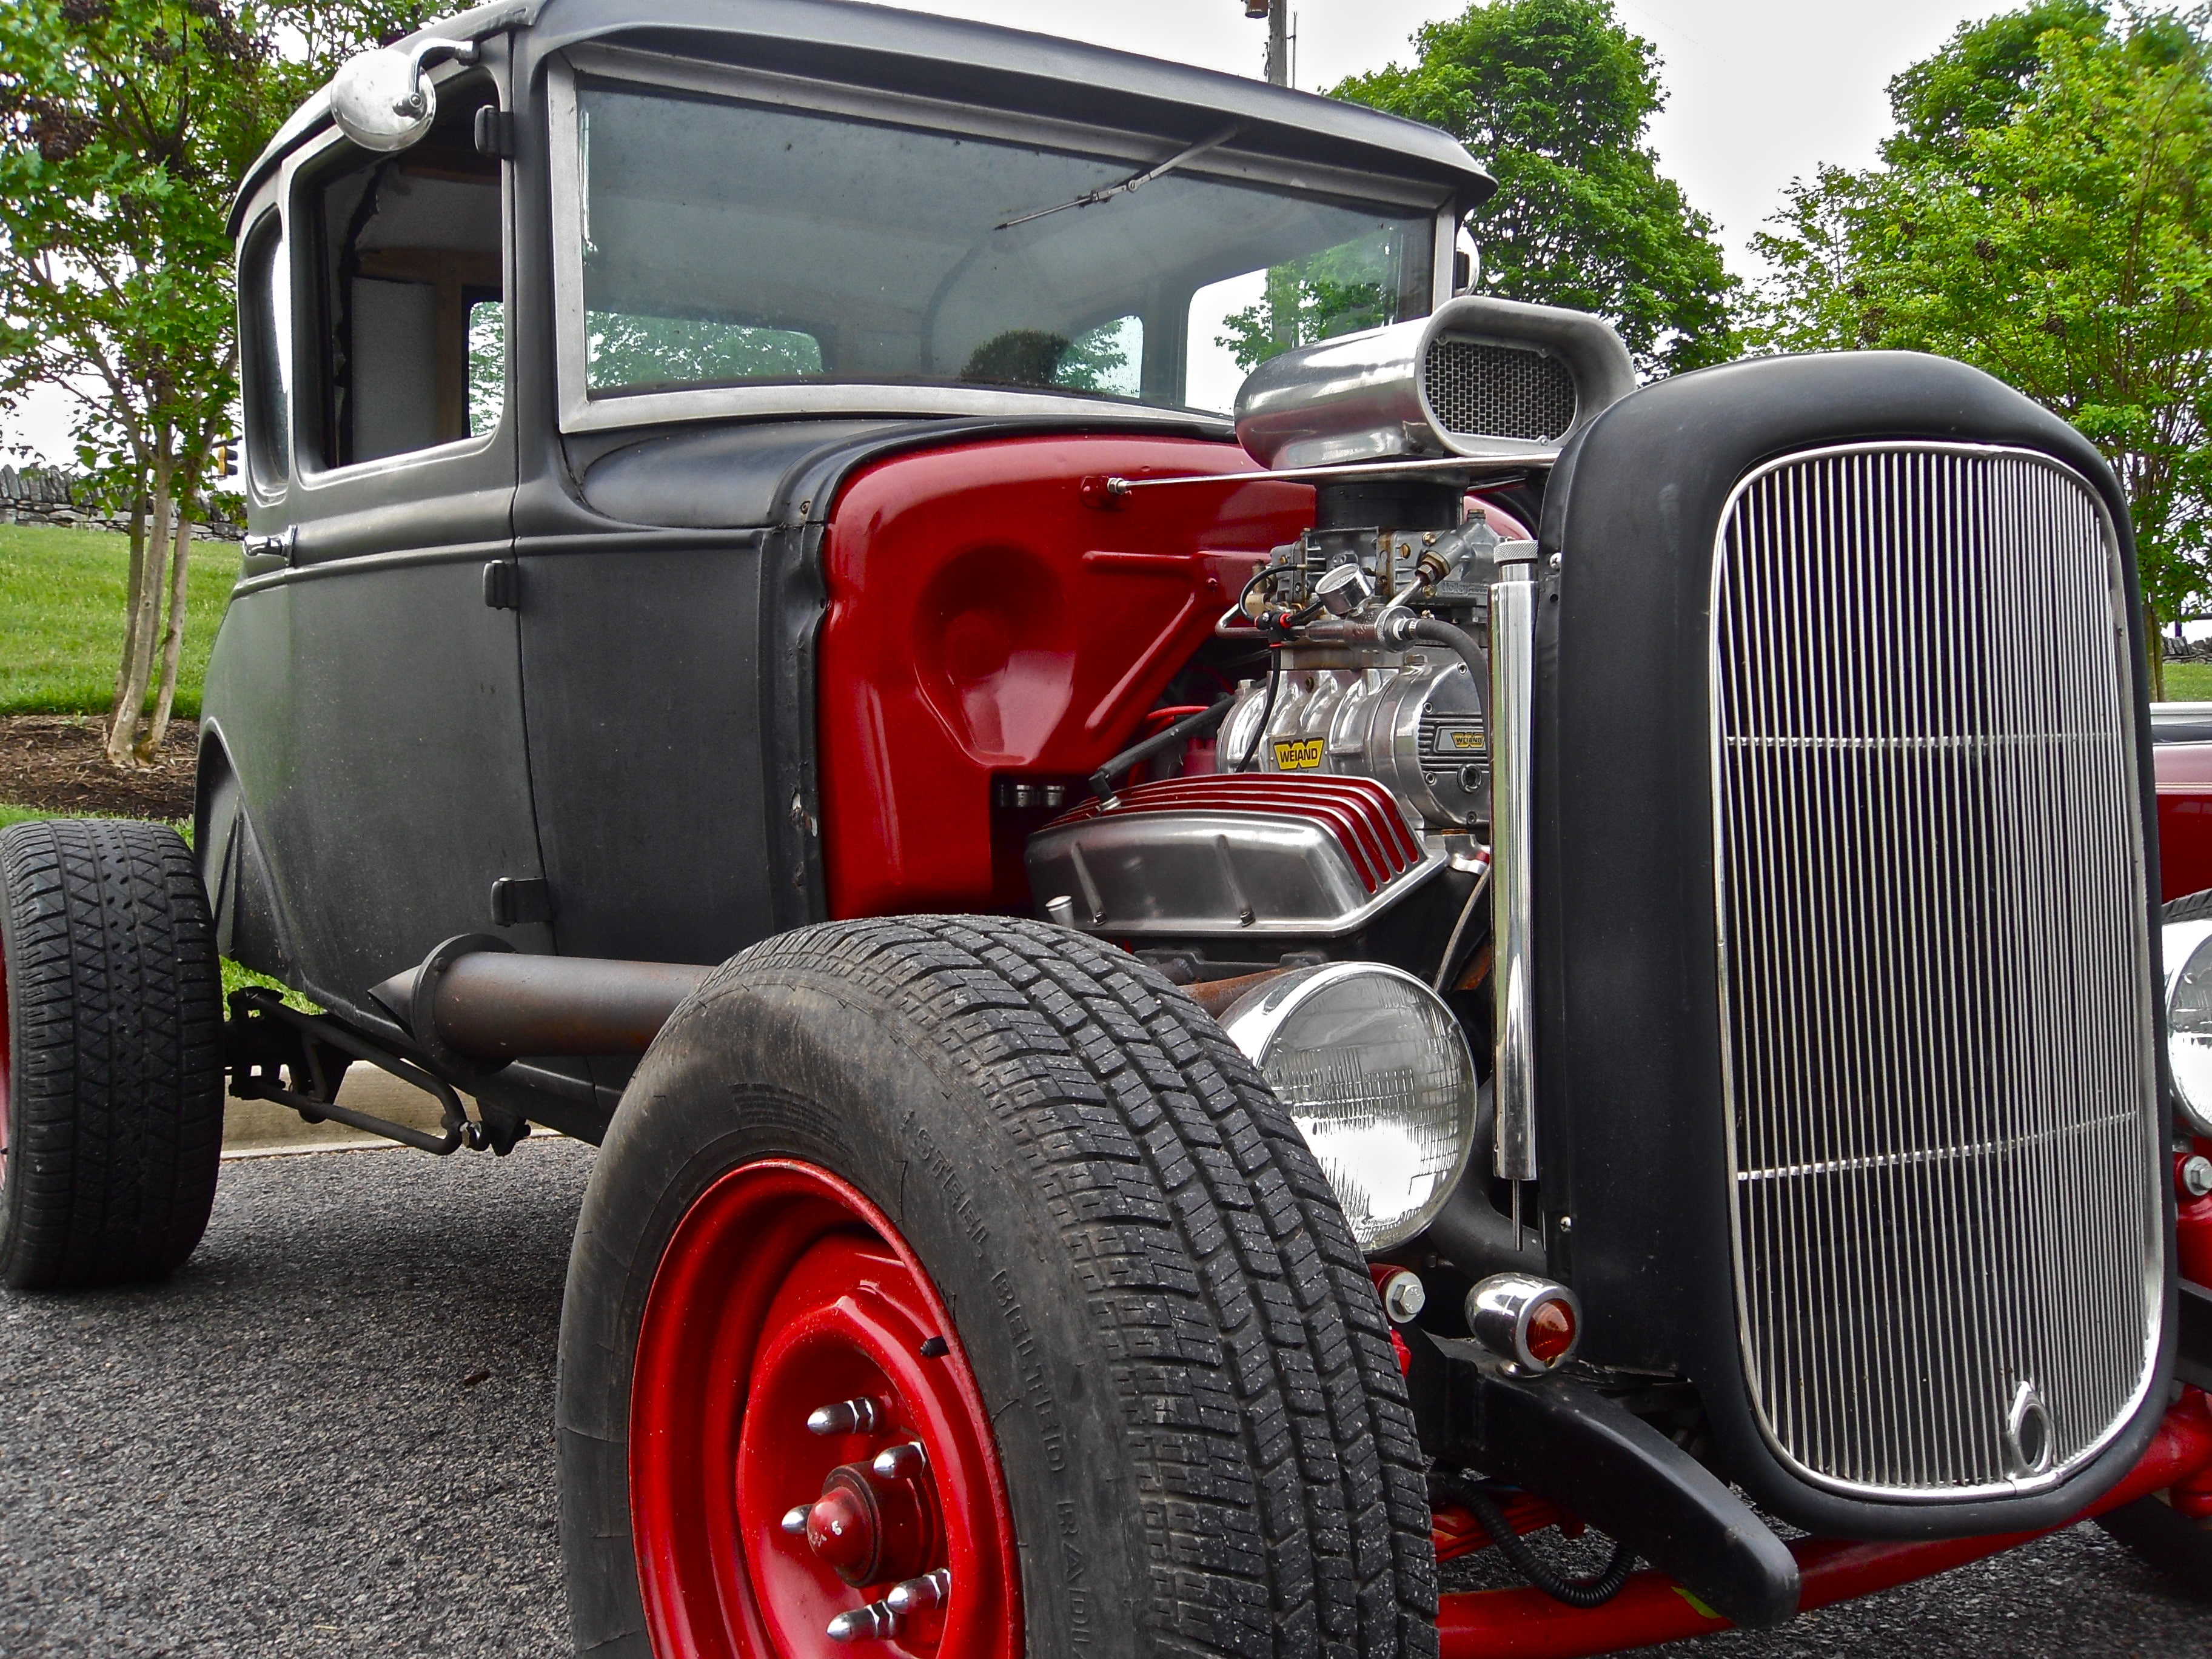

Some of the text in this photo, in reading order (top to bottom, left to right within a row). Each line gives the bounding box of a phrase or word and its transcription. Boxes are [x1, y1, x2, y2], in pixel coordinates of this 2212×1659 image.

[1279, 748, 1318, 763] WEIAND
[913, 1128, 990, 1258] STEEL
[991, 1269, 1065, 1471] BELTED
